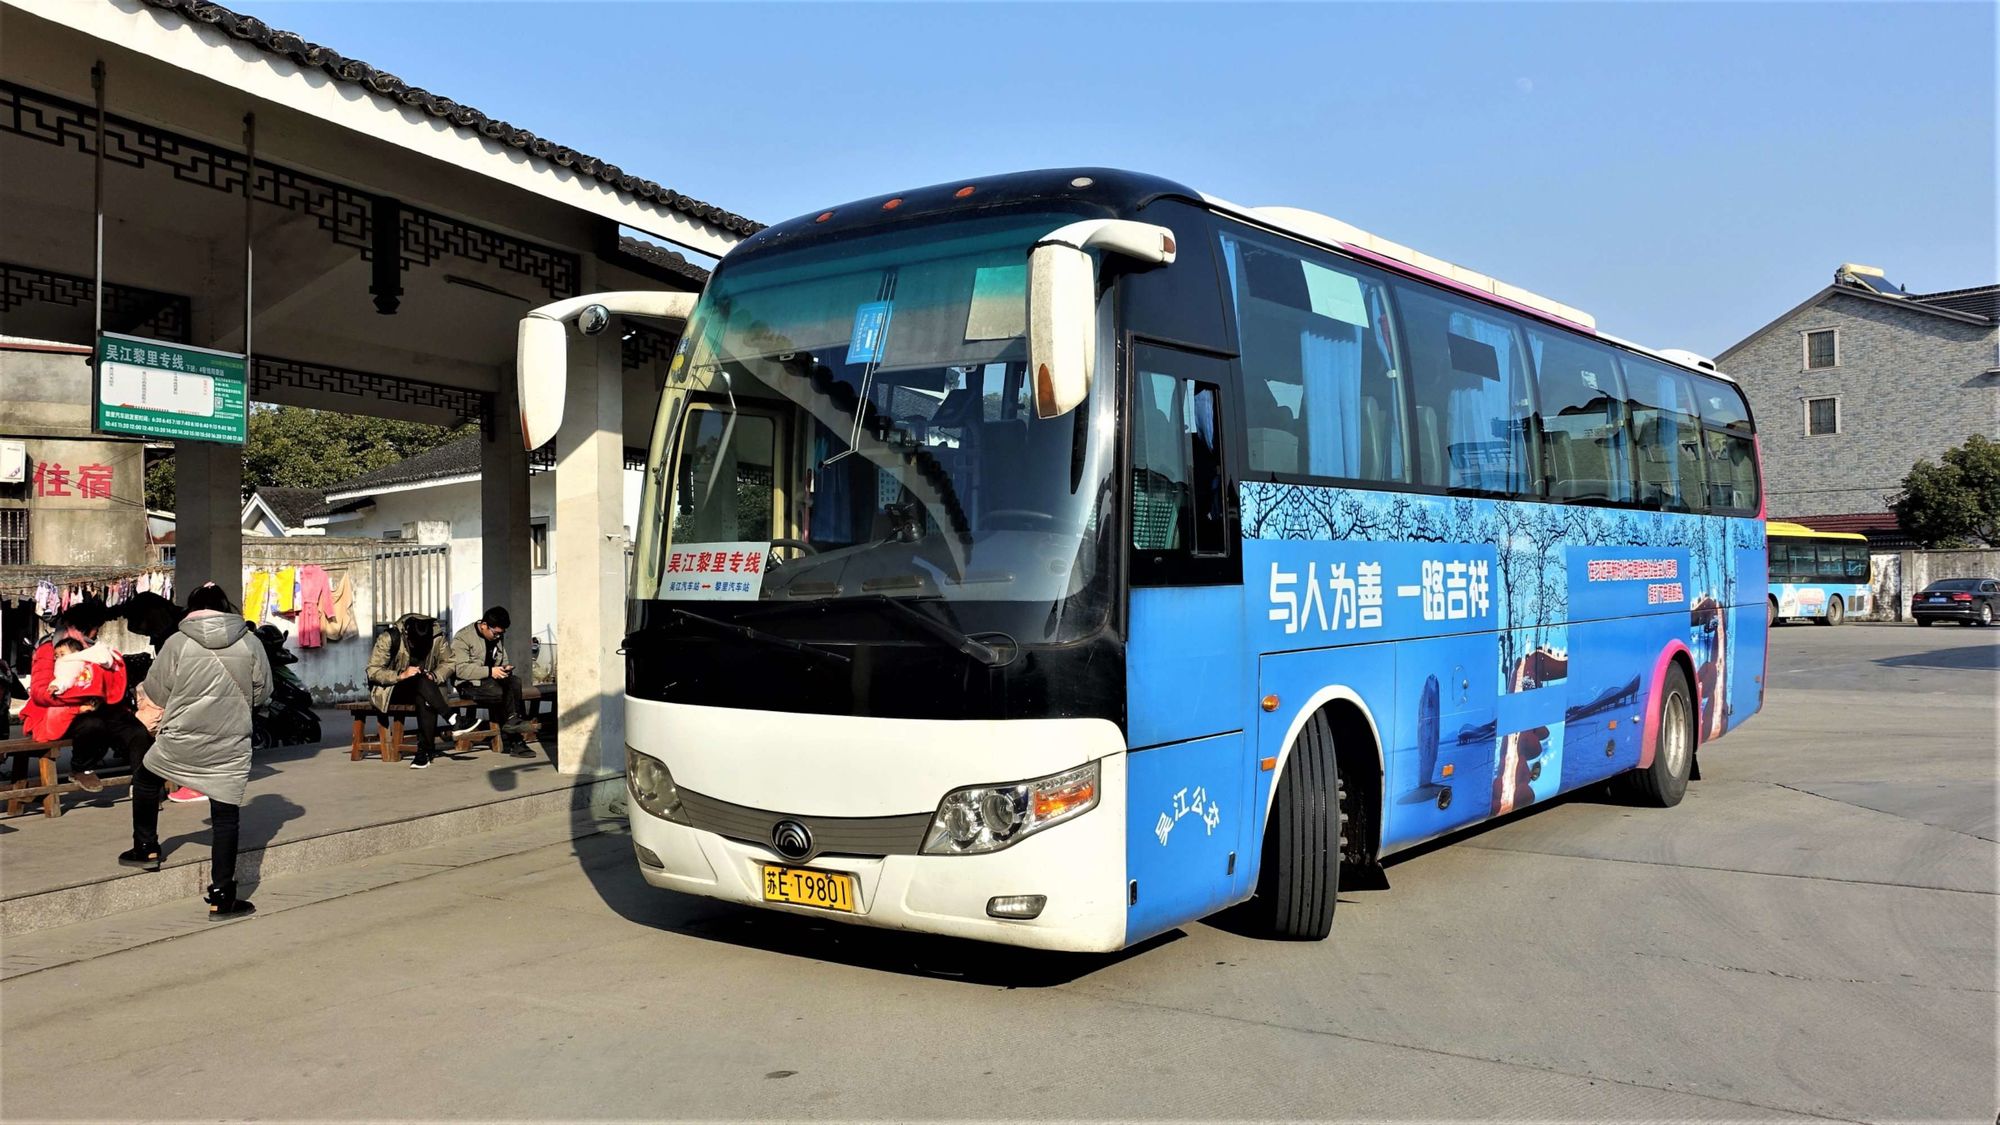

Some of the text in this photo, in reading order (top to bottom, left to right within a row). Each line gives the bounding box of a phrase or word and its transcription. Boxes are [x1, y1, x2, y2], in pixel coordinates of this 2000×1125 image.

[106, 344, 184, 370] 吴江黎里专线
[33, 462, 113, 499] 住宿
[667, 551, 761, 574] 吴江黎里专线
[669, 581, 750, 592] 吴江汽车站 黎里汽车站
[1269, 559, 1490, 634] 与人为善 一路吉祥
[1155, 785, 1220, 846] 吴江公交
